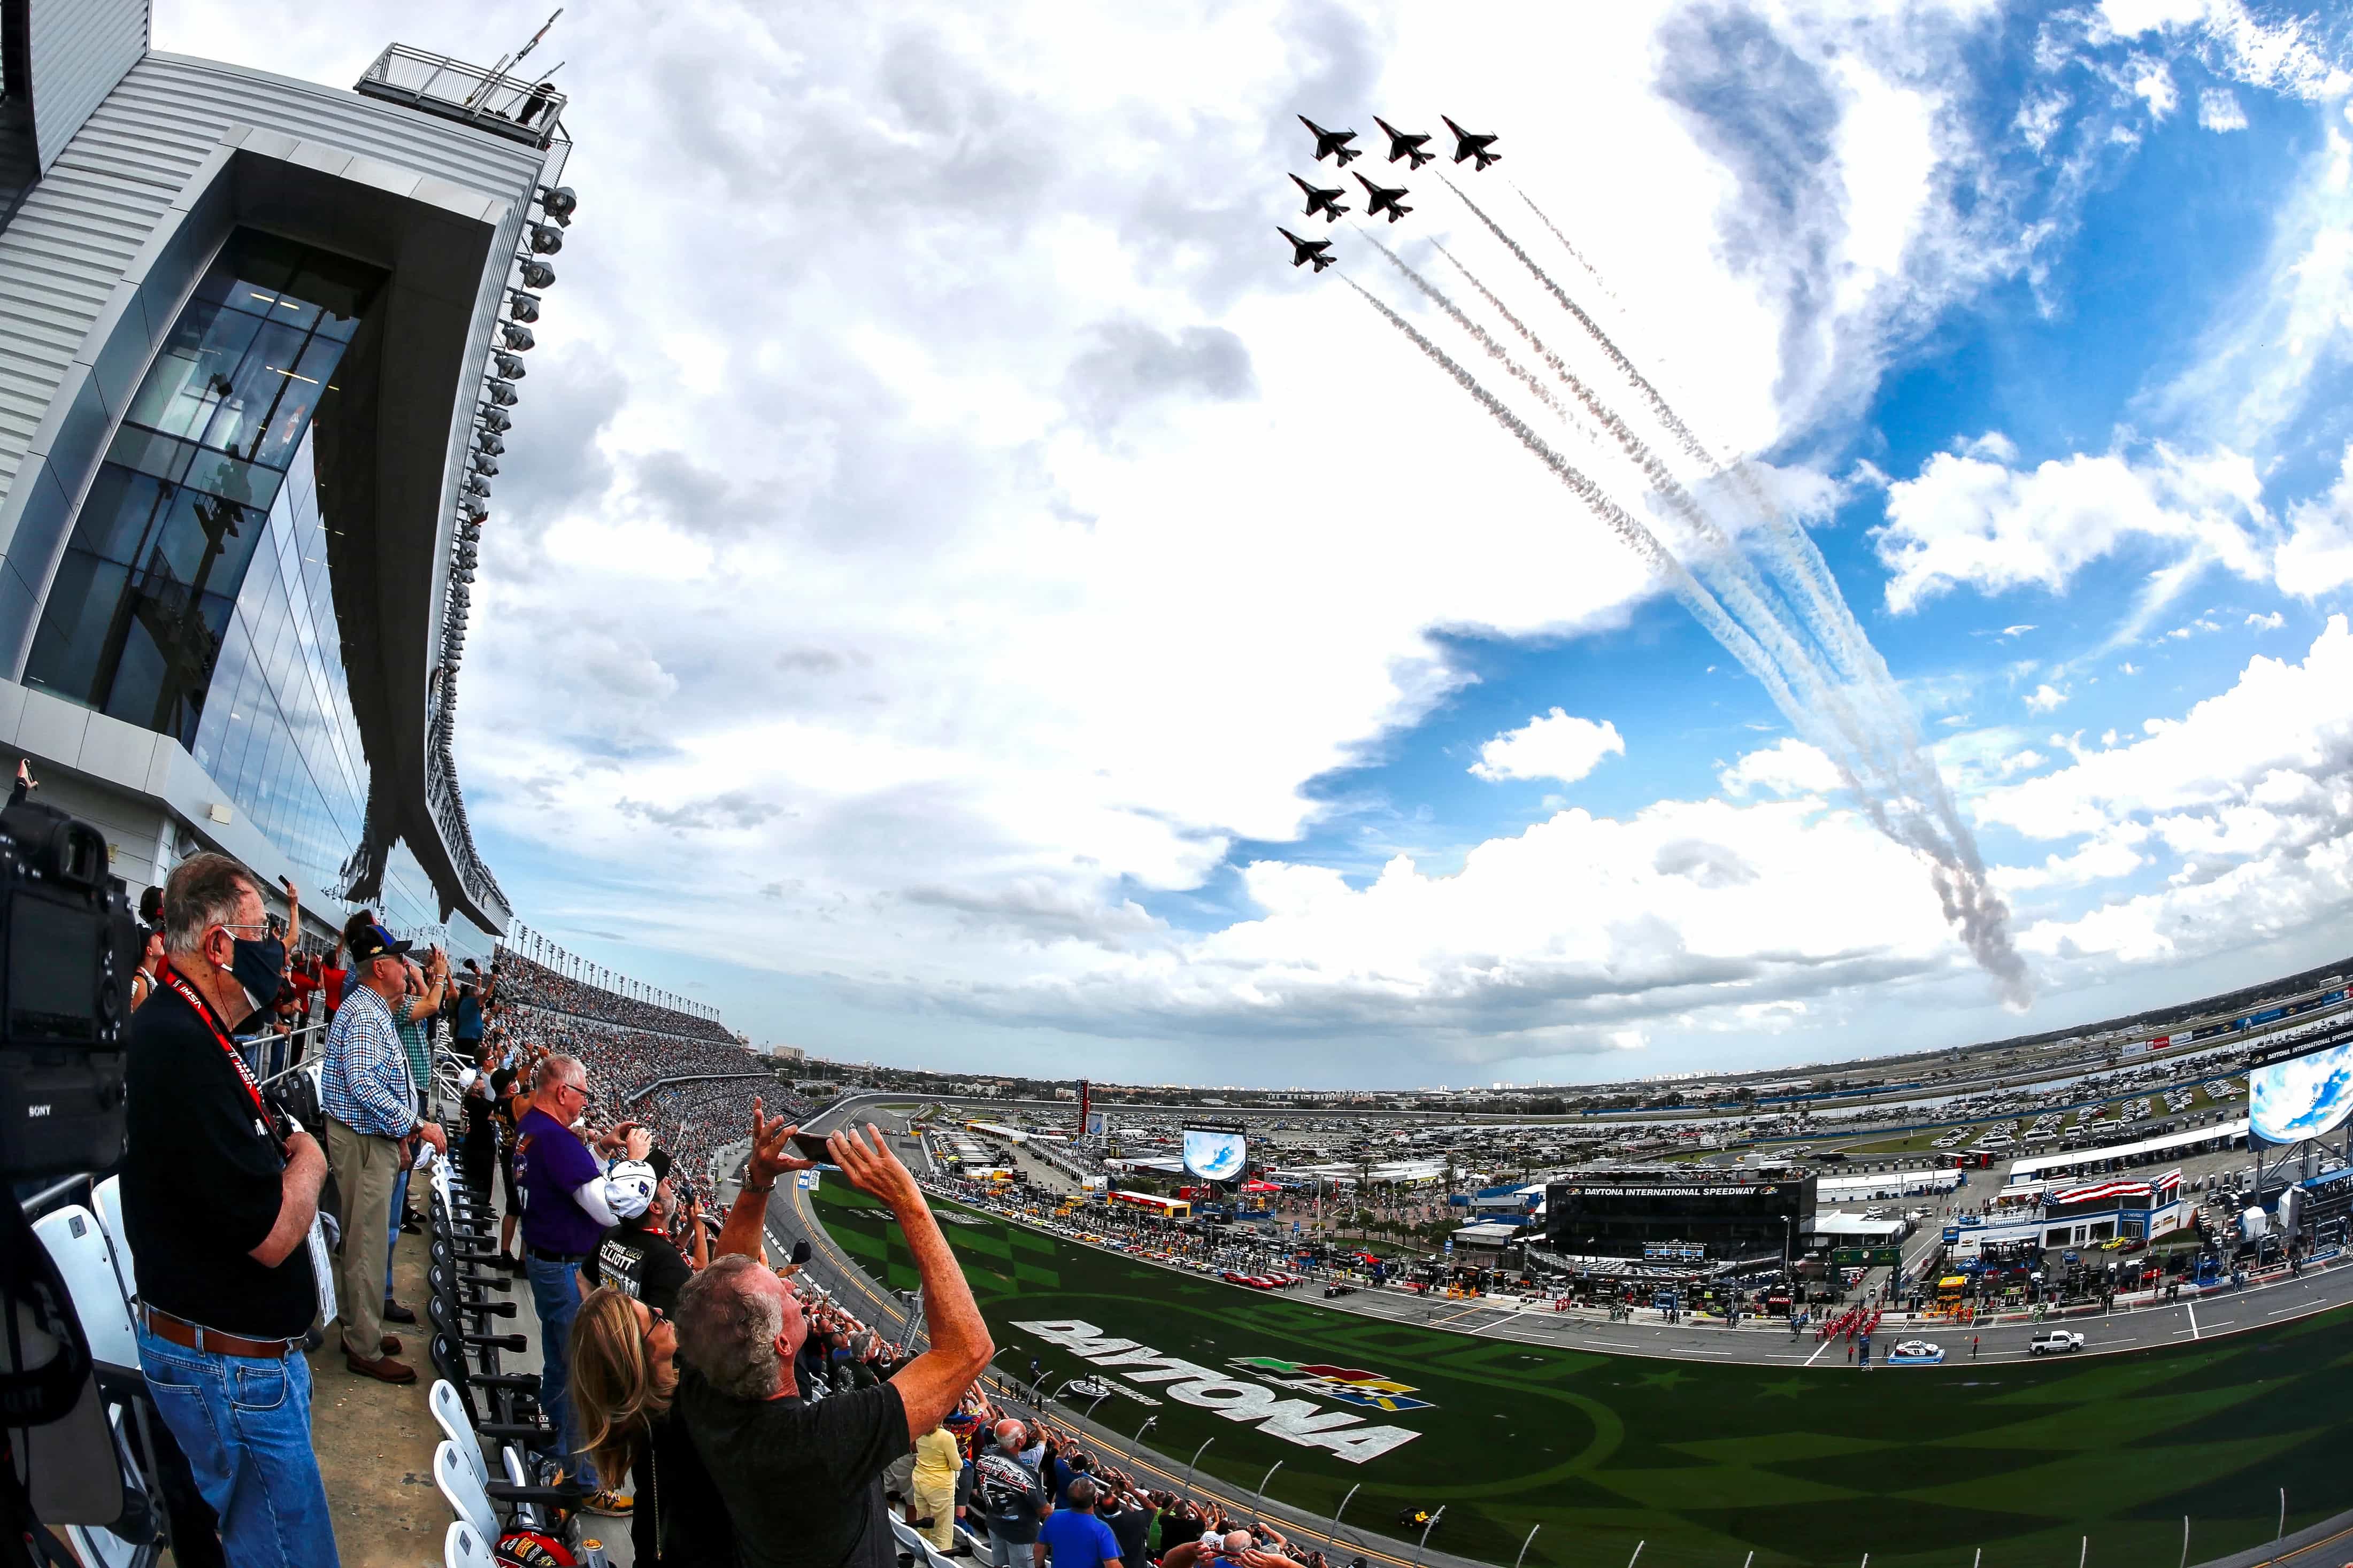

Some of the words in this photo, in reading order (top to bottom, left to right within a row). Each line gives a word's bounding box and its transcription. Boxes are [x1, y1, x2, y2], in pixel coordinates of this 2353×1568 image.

[179, 986, 202, 1009] IMSA
[2267, 1048, 2290, 1060] DAYTONA
[2292, 1038, 2331, 1053] INTERNATIONAL
[2331, 1030, 2353, 1042] SPEEDWA
[234, 1062, 253, 1090] IMSA
[29, 1104, 51, 1117] SONY
[1585, 1187, 1624, 1196] DAYTONA
[1625, 1188, 1700, 1196] INTERNATIONAL
[1703, 1187, 1756, 1196] SPEEDWAY
[75, 1222, 81, 1232] 2
[600, 1244, 636, 1271] ELLIOTT
[607, 1240, 627, 1255] CHASE
[625, 1246, 644, 1261] 2020
[1008, 1319, 1423, 1464] DAYTONA
